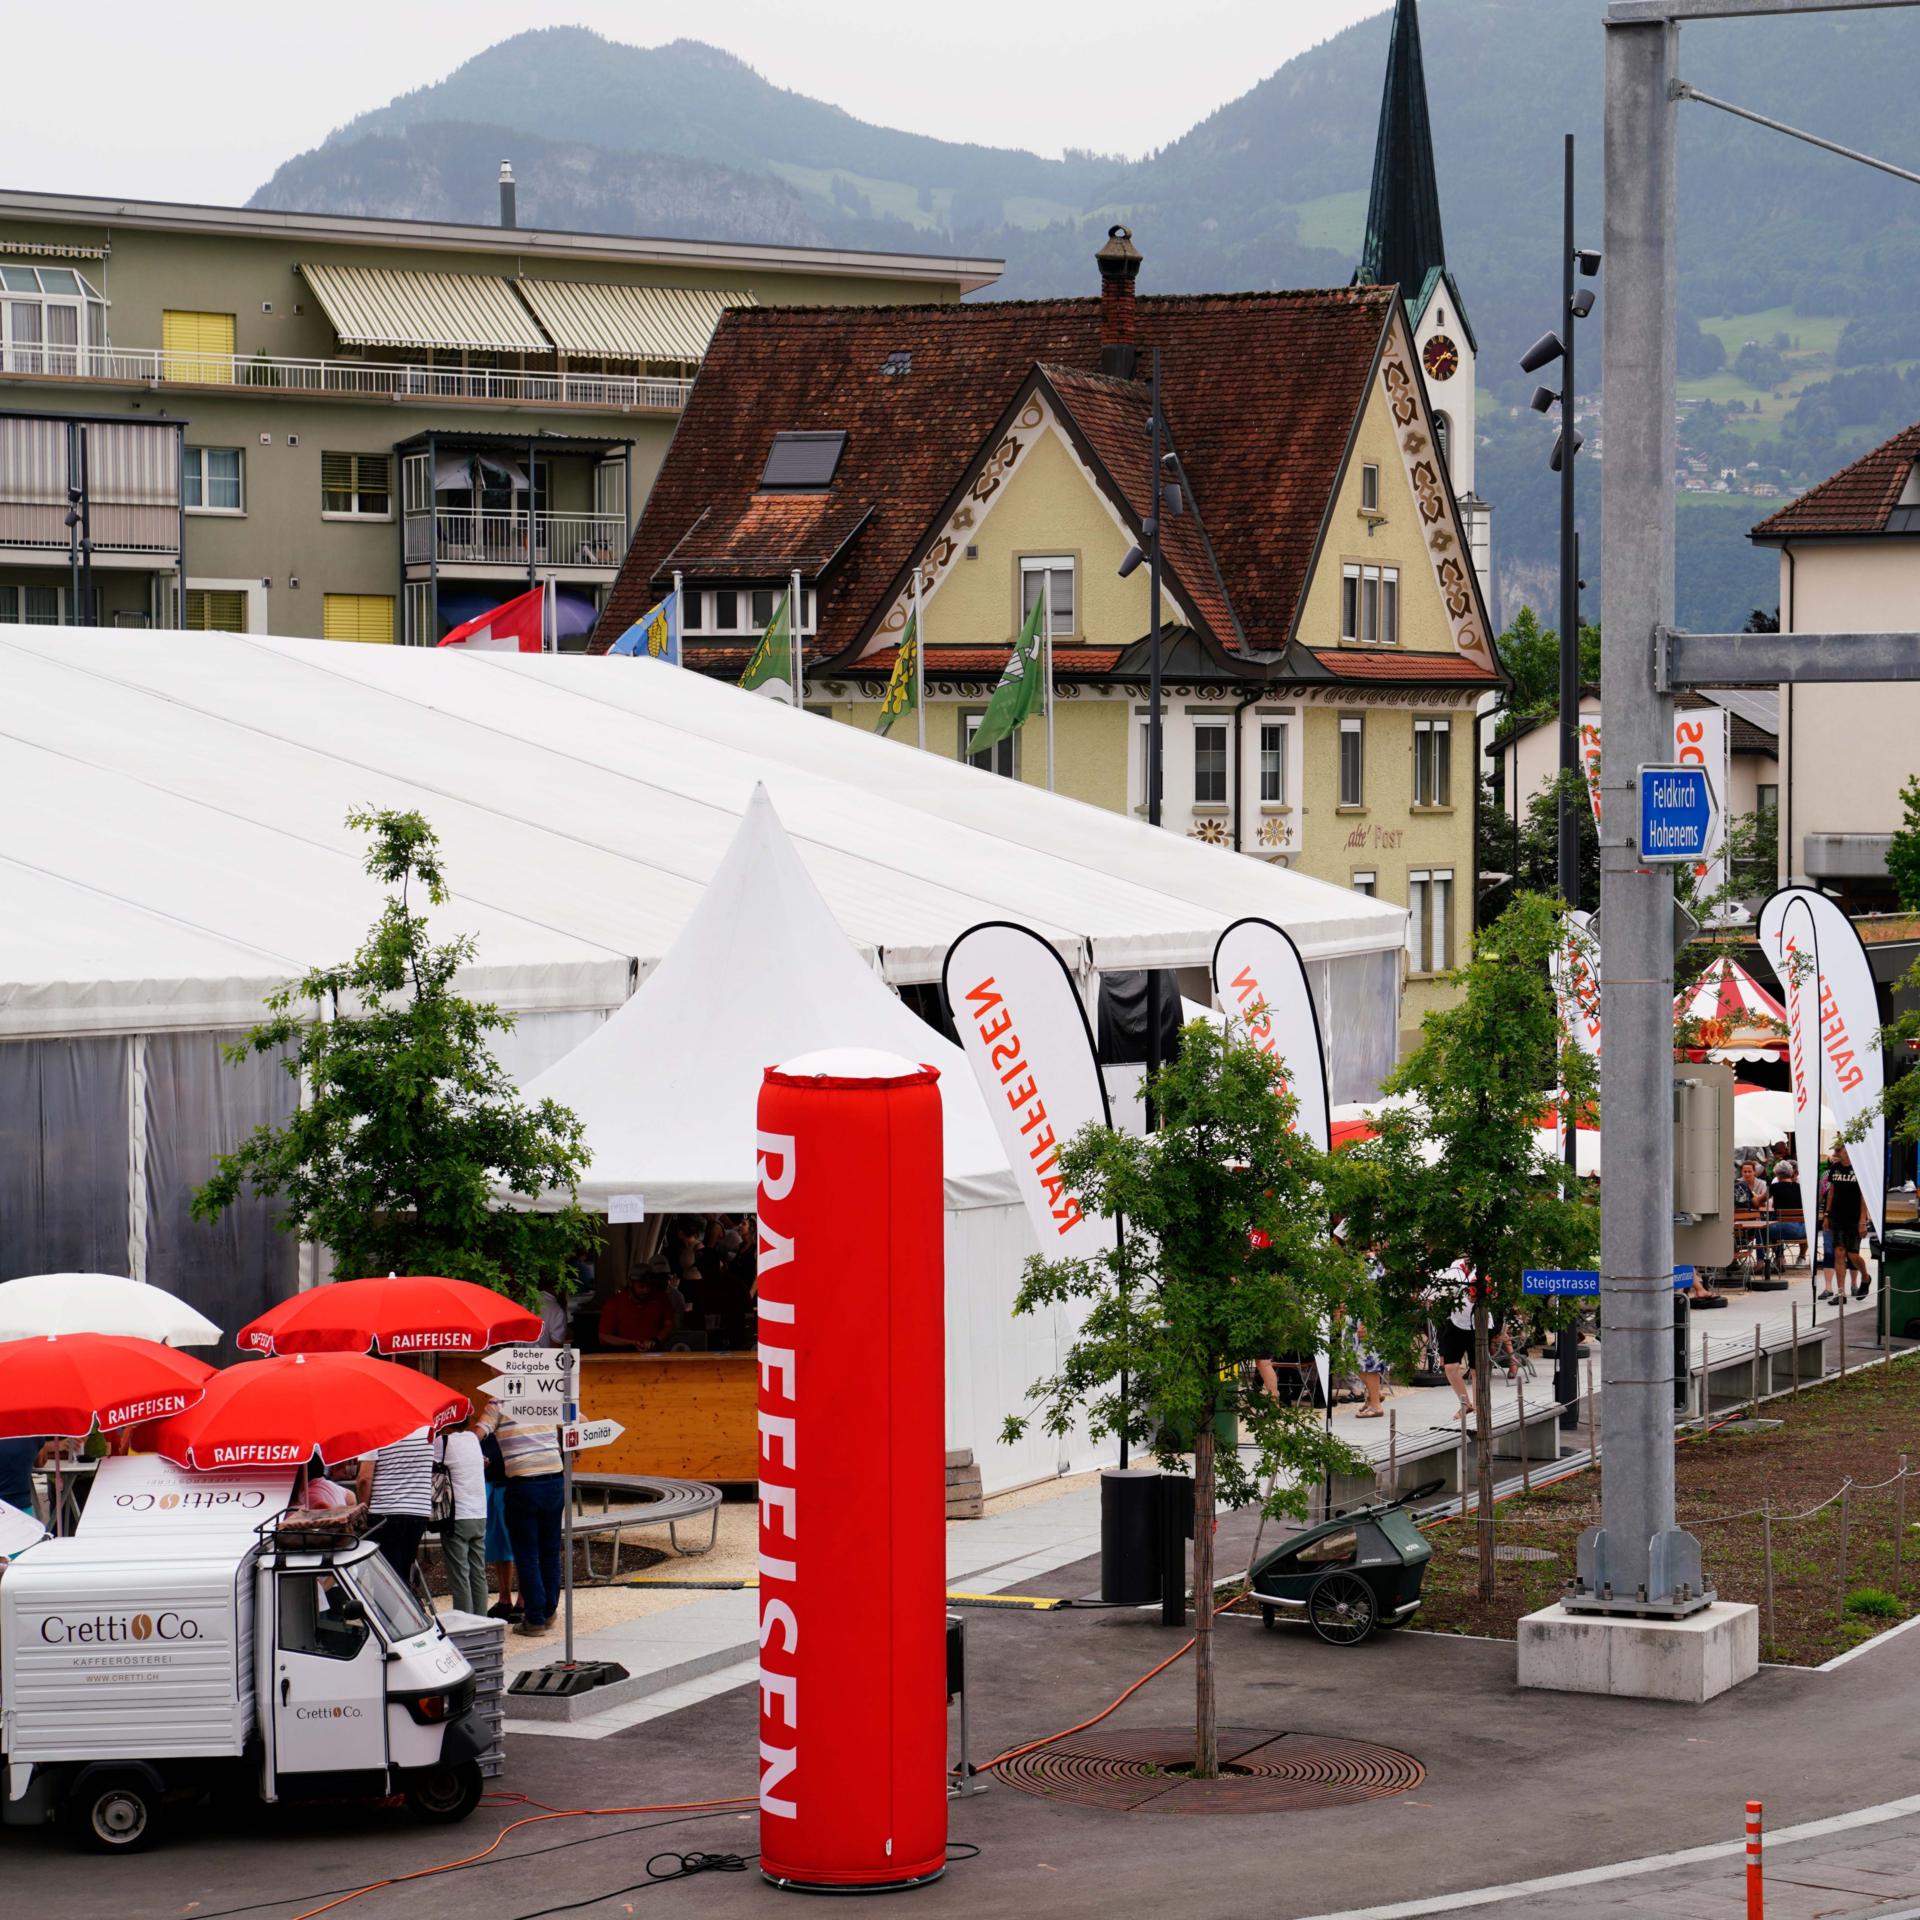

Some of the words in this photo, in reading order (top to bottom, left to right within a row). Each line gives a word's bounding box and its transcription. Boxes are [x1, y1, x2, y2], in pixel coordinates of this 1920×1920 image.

[1653, 778, 1696, 809] Feldkirch
[1649, 817, 1699, 848] Hohenems
[1526, 1275, 1597, 1292] Steigstrasse
[391, 1332, 472, 1348] RAIFFEISEN
[512, 1349, 543, 1359] Becher
[506, 1361, 550, 1373] Rückgabe
[108, 1395, 185, 1425] RAIFFEISEN
[512, 1406, 559, 1416] INFO-DESK
[583, 1426, 611, 1441] Sanität
[214, 1444, 300, 1462] RAIFFEISEN
[757, 1128, 800, 1820] RAIFFEISEN
[113, 1493, 156, 1511] Co.
[181, 1491, 266, 1509] Cretti
[41, 1615, 127, 1644] Cretti
[156, 1612, 204, 1640] Co.
[73, 1655, 172, 1666] KAFFEERÖSTEREI
[86, 1673, 159, 1682] WWW.CRETTI.CH
[296, 1706, 332, 1720] Cretti
[343, 1705, 363, 1718] Co.
